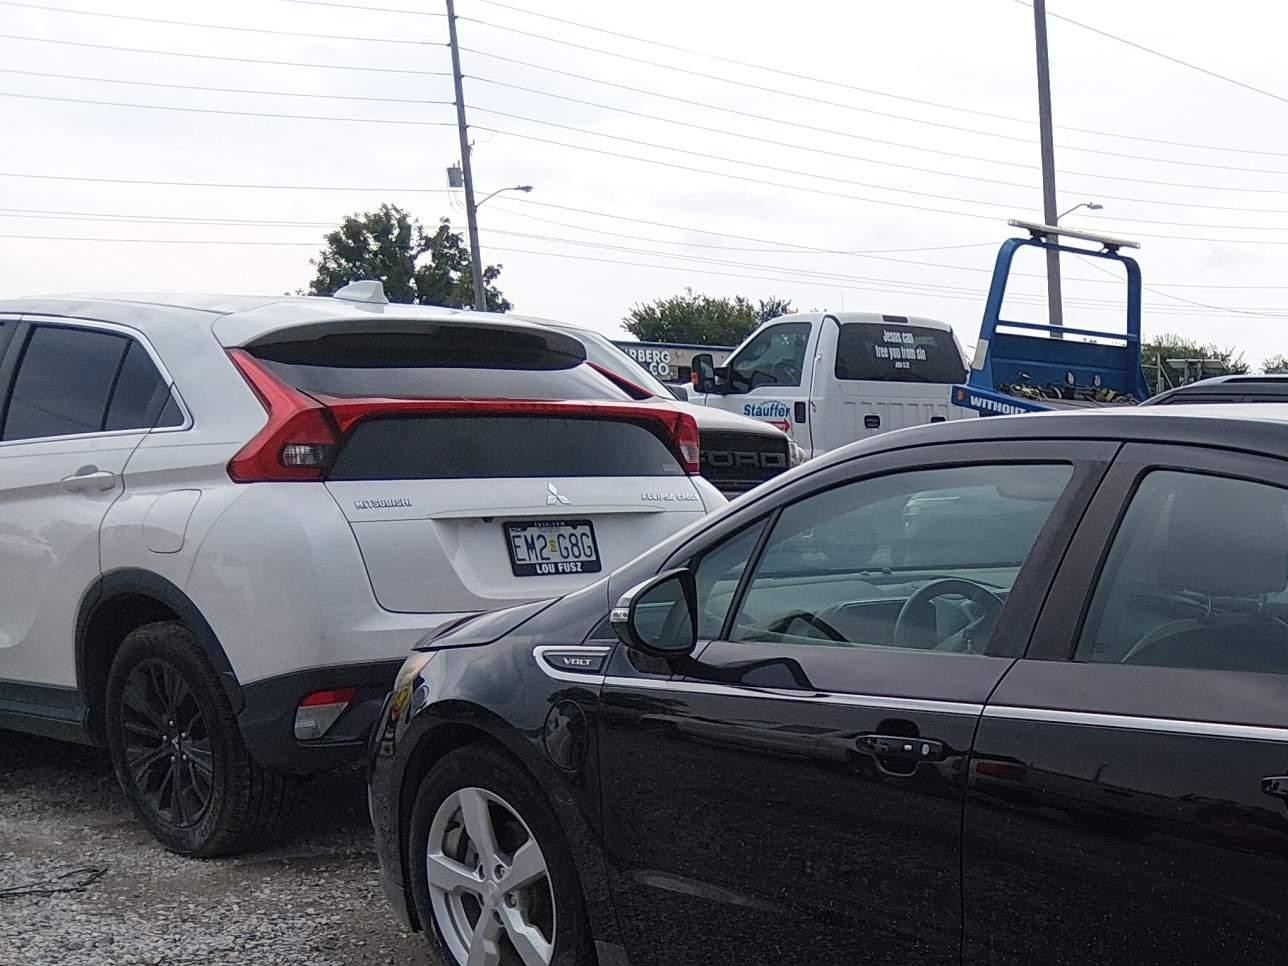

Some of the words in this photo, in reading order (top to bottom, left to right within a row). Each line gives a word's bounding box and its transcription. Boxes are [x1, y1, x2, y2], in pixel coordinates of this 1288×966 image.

[743, 403, 791, 417] Stauffer
[970, 395, 1027, 415] WITHOUT
[701, 450, 786, 467] ORD
[512, 534, 551, 562] EM2
[557, 533, 593, 559] G8G
[536, 563, 555, 574] LOU
[558, 562, 583, 572] FUSZ
[563, 656, 593, 666] VOLT
